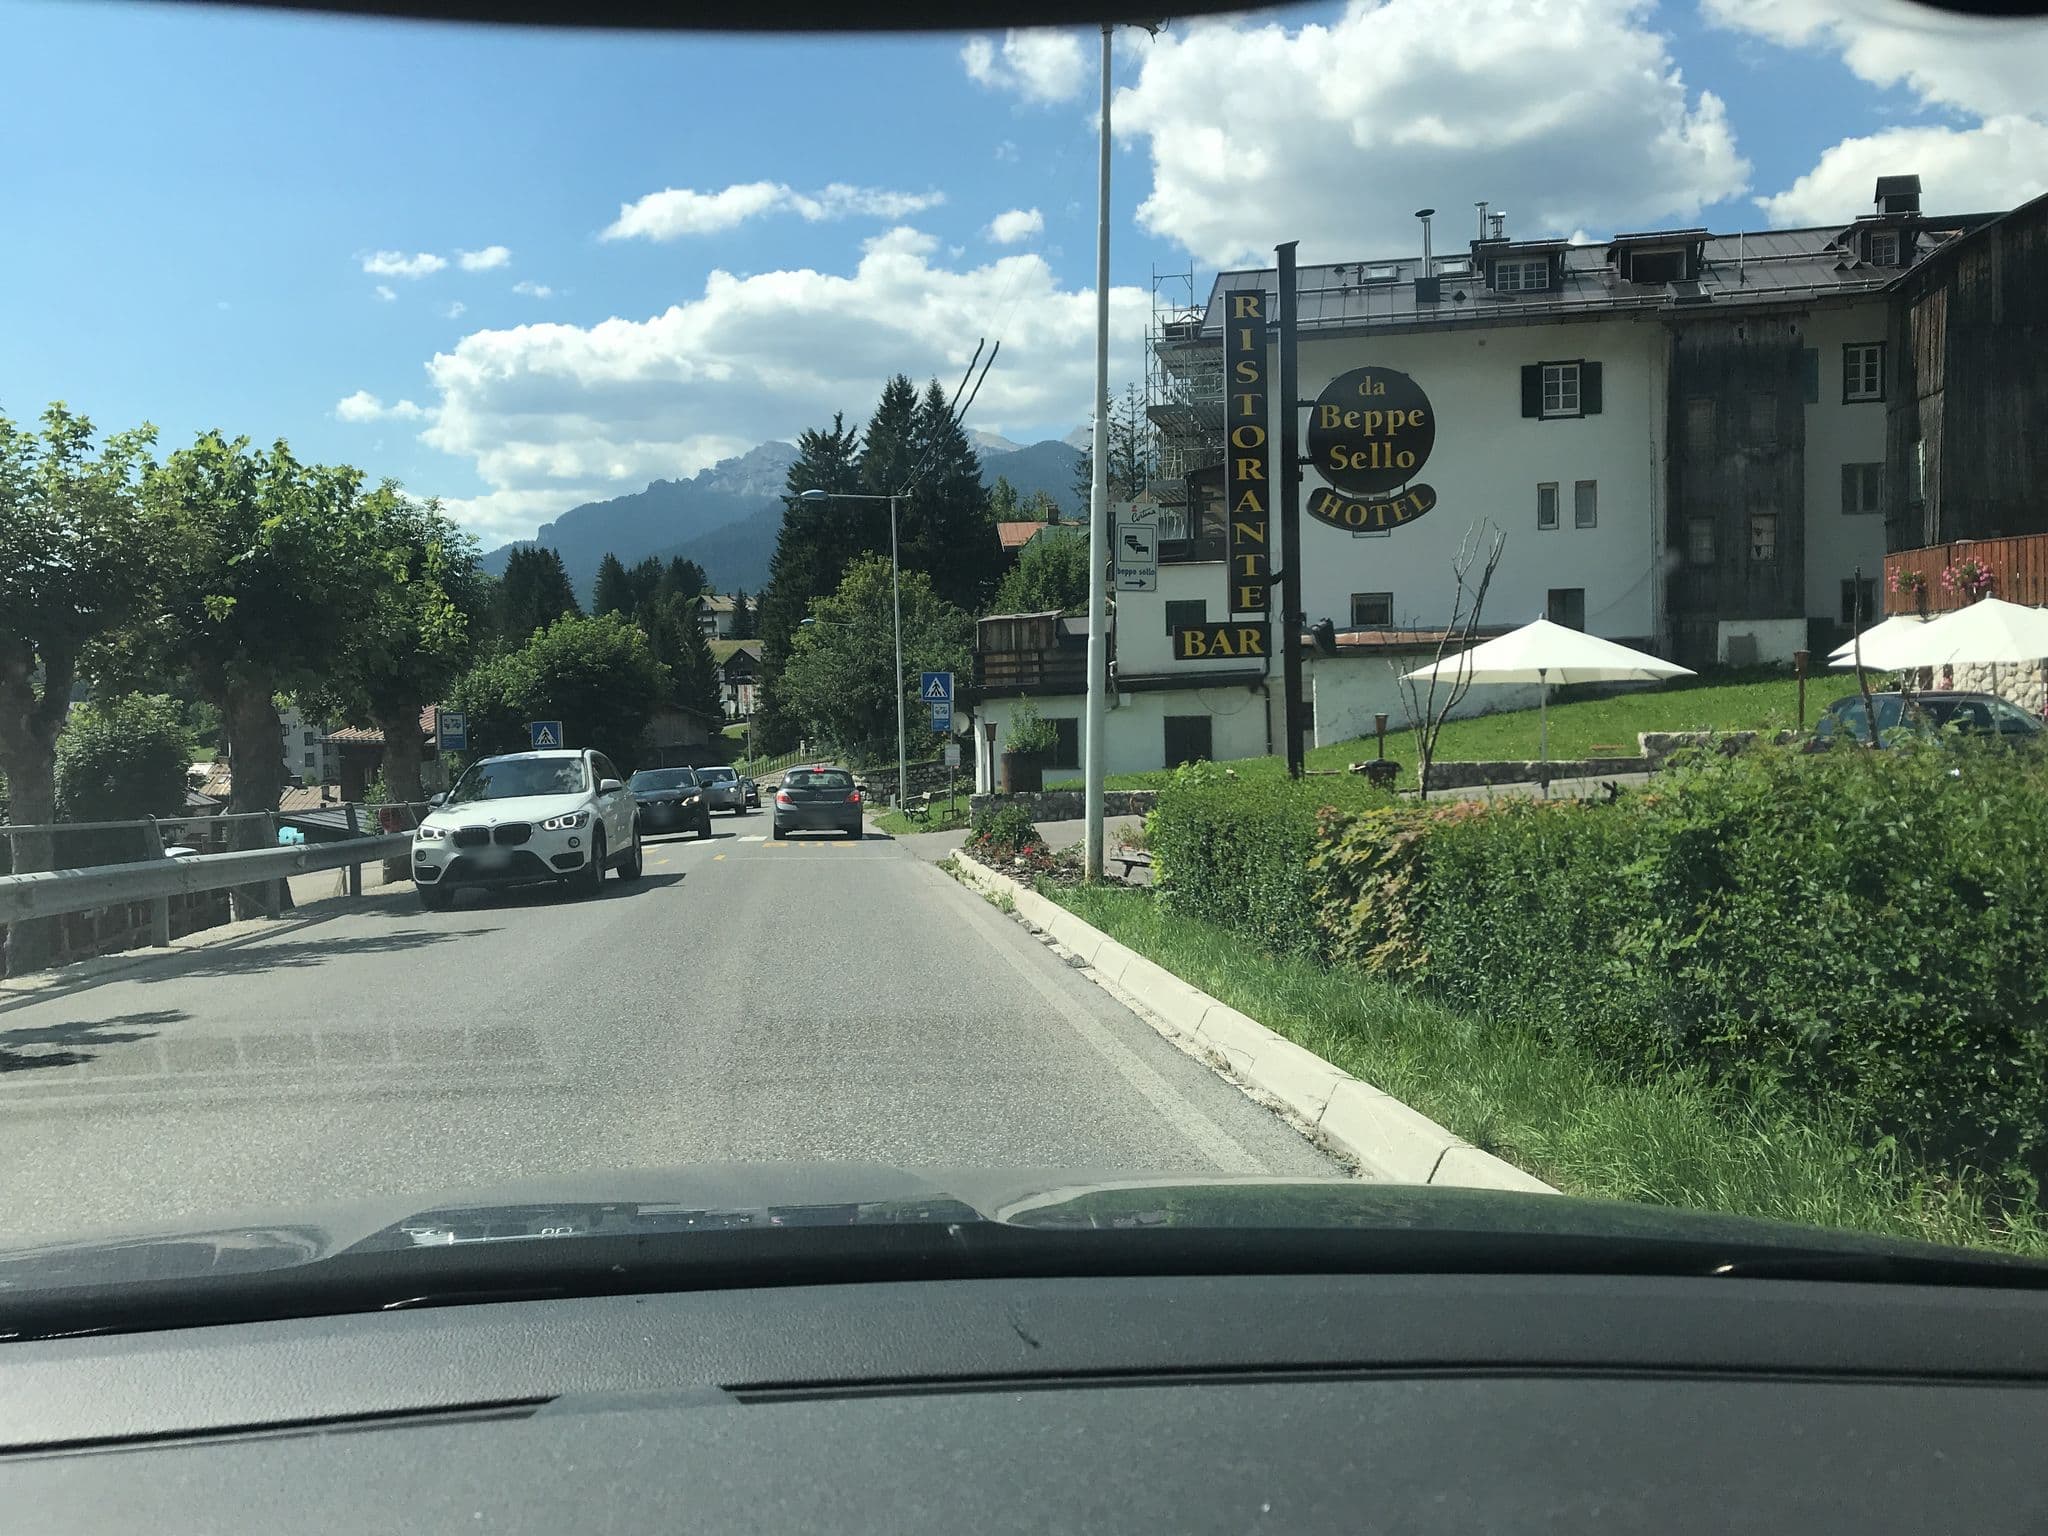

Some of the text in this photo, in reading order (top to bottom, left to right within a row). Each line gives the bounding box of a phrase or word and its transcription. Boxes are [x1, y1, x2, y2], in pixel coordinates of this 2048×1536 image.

[1358, 376, 1385, 396] da
[1319, 404, 1425, 437] Beppe
[1232, 296, 1265, 609] RISTORANTE
[1329, 441, 1416, 471] Sello
[1318, 492, 1432, 527] HOTEL
[1182, 628, 1265, 657] BAR
